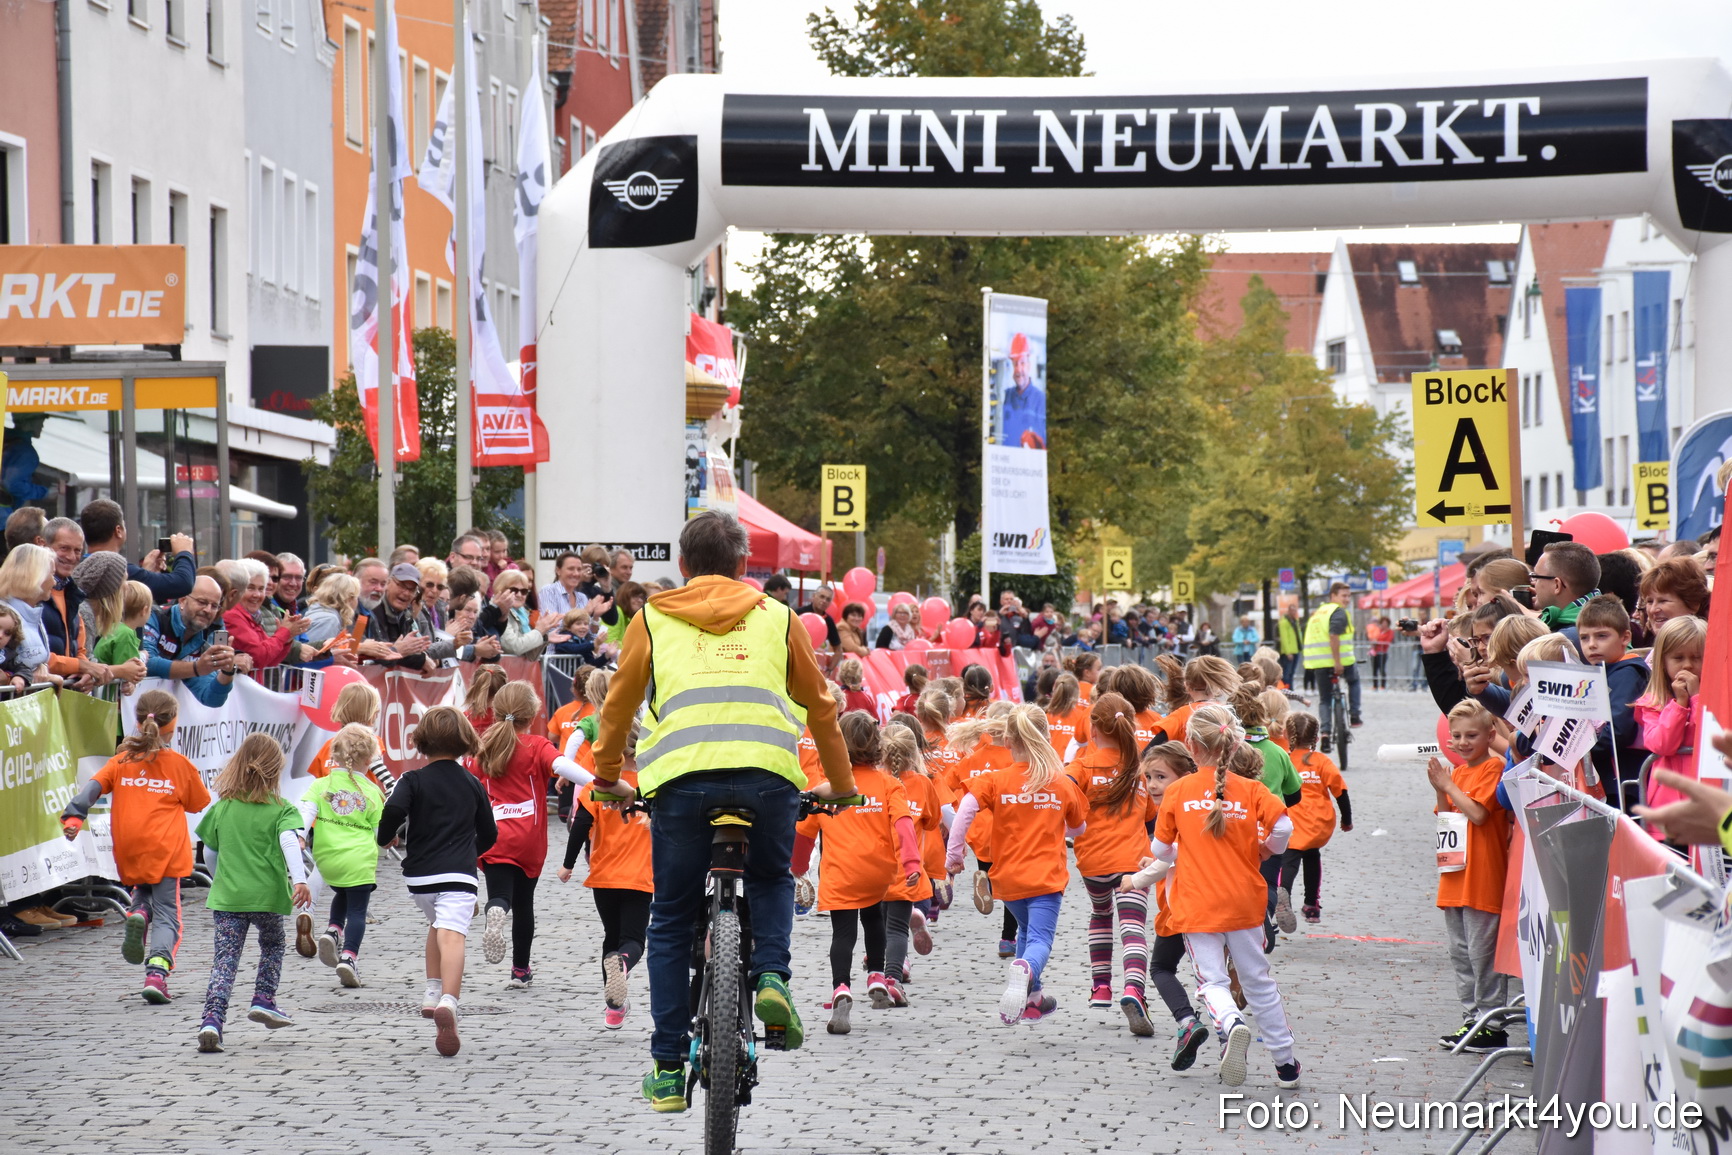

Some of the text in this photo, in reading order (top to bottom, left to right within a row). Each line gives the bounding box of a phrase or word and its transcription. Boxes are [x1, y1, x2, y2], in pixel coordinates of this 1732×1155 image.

[802, 96, 1557, 173] MINI NEUMARKT.
[629, 185, 656, 196] MINI
[6, 386, 108, 406] MARKT.DE
[1425, 376, 1507, 405] Block
[482, 410, 528, 430] AVIA
[1438, 418, 1499, 492] A
[827, 469, 860, 480] Block
[1639, 466, 1668, 478] Bloc
[833, 485, 854, 516] B
[1647, 483, 1669, 514] B
[1107, 549, 1128, 557] Block
[1110, 559, 1124, 579] C
[1178, 581, 1189, 596] D
[1538, 680, 1573, 698] swn
[1517, 697, 1534, 726] sw
[1561, 698, 1586, 706] neumarkt
[5, 723, 23, 748] Der
[176, 724, 204, 760] BMW
[1552, 717, 1579, 757] swn
[1417, 744, 1438, 753] swn
[503, 807, 523, 815] DEHN
[856, 806, 883, 814] energie
[1033, 803, 1061, 811] energie
